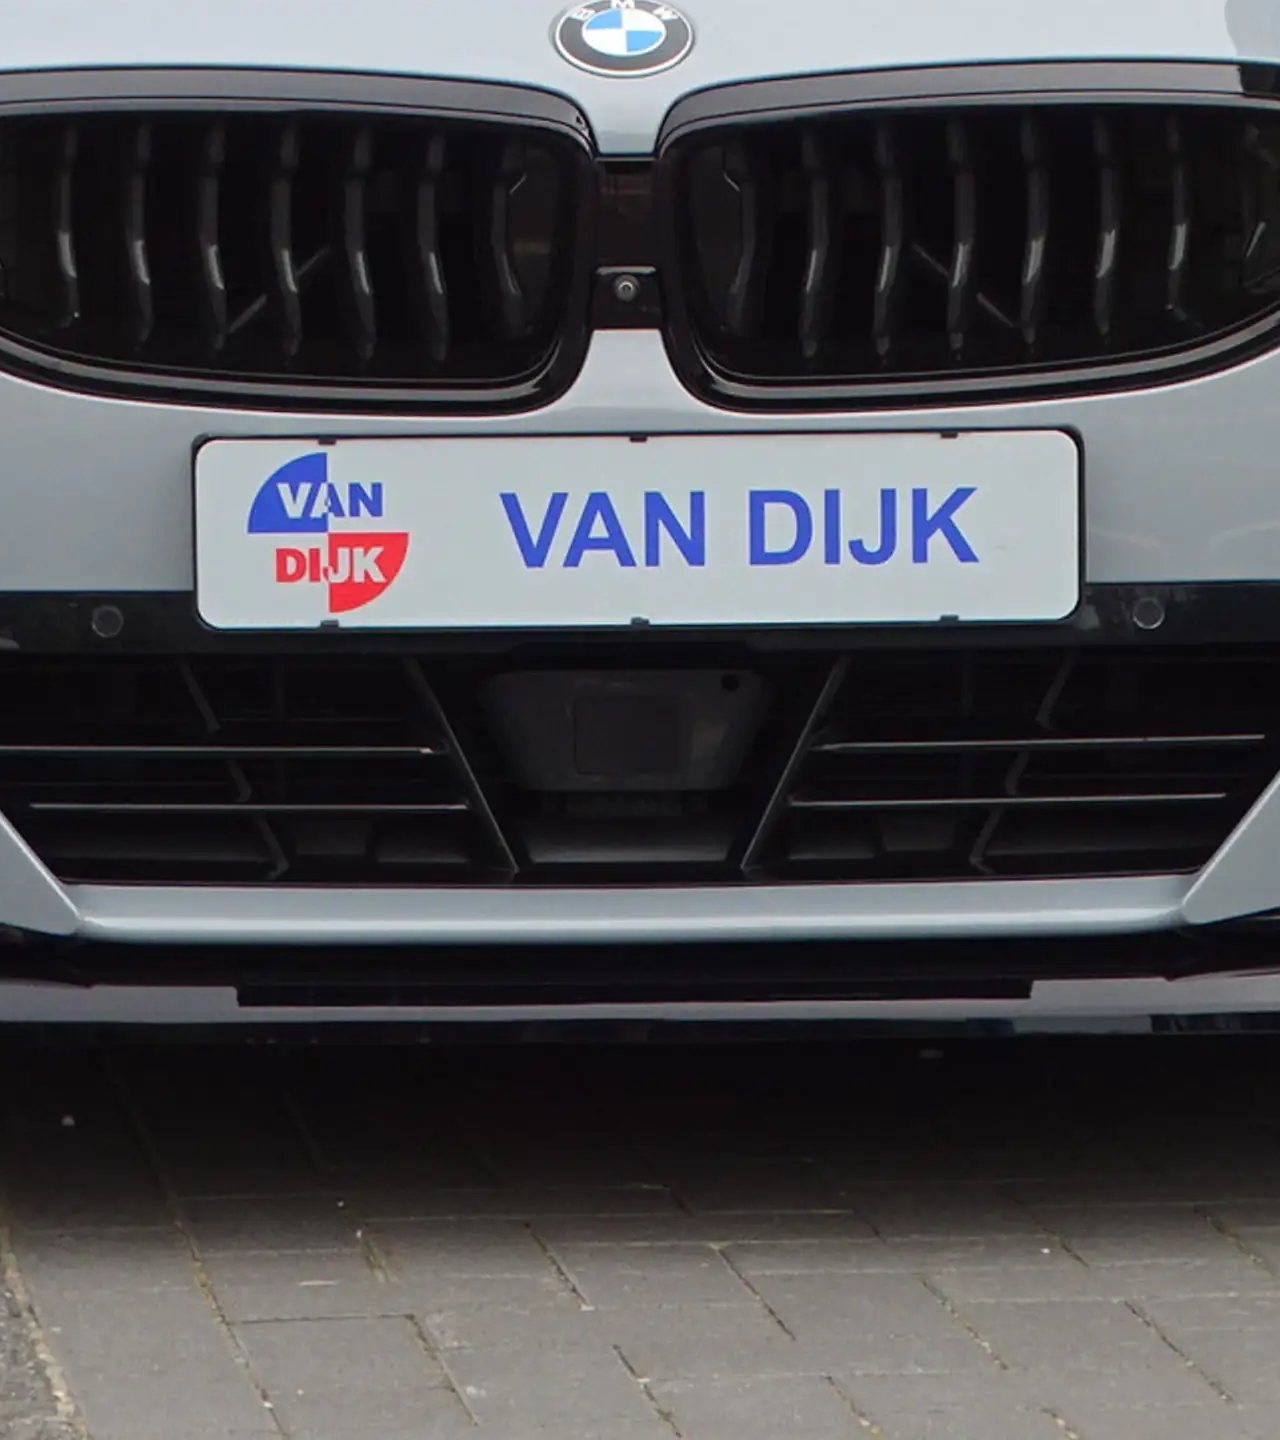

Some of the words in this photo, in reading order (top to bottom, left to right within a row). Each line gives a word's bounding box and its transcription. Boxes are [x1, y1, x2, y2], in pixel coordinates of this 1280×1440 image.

[276, 482, 383, 519] VAN
[499, 490, 706, 568] VAN
[748, 486, 981, 566] DIJK
[275, 546, 387, 583] DIJK
